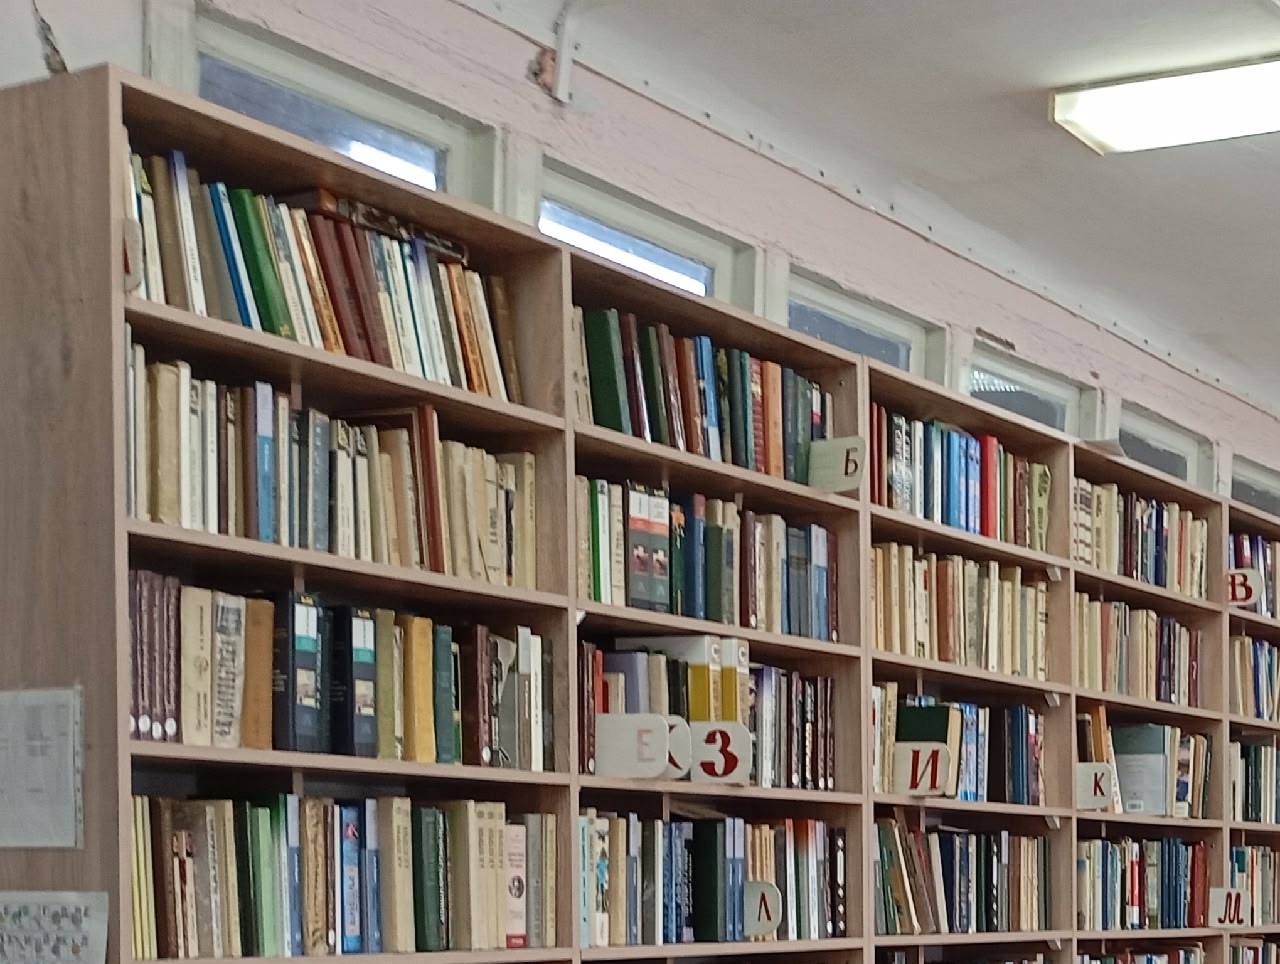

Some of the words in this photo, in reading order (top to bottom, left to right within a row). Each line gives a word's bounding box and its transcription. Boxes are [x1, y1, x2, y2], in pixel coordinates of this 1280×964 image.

[845, 448, 859, 478] Б
[1228, 572, 1253, 602] В
[637, 729, 656, 762] Е
[700, 729, 739, 777] З
[909, 749, 940, 790] И
[1093, 772, 1105, 797] К
[758, 892, 771, 921] Л
[1218, 892, 1244, 924] М
